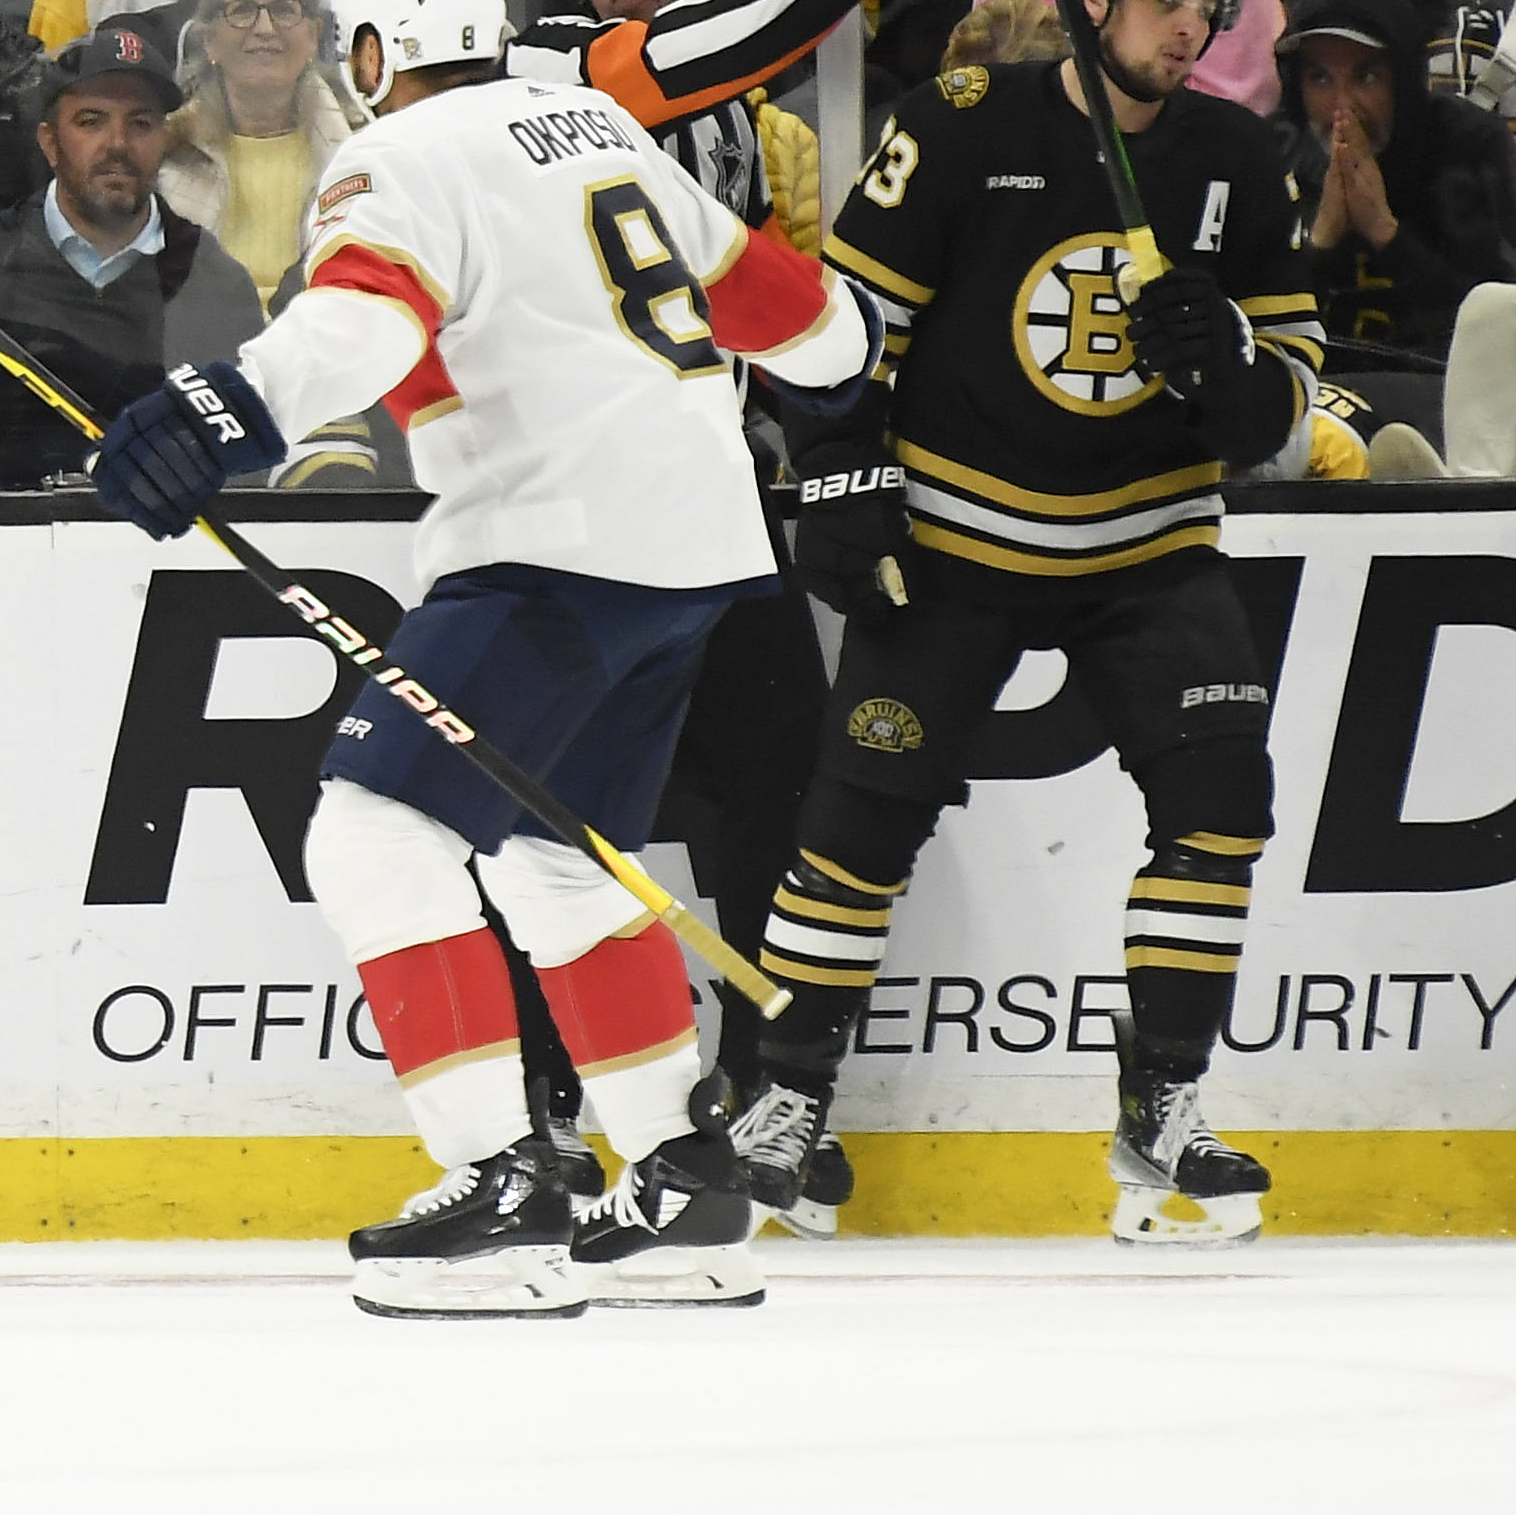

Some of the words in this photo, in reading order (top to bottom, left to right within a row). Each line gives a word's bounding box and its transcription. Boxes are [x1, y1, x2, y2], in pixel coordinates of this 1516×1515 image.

[462, 26, 474, 50] 8
[1192, 178, 1231, 253] A
[582, 172, 735, 380] 8
[1059, 271, 1137, 374] B
[166, 361, 243, 446] UER
[91, 983, 391, 1062] OFFIC
[697, 971, 1516, 1056] ERSEURITY
